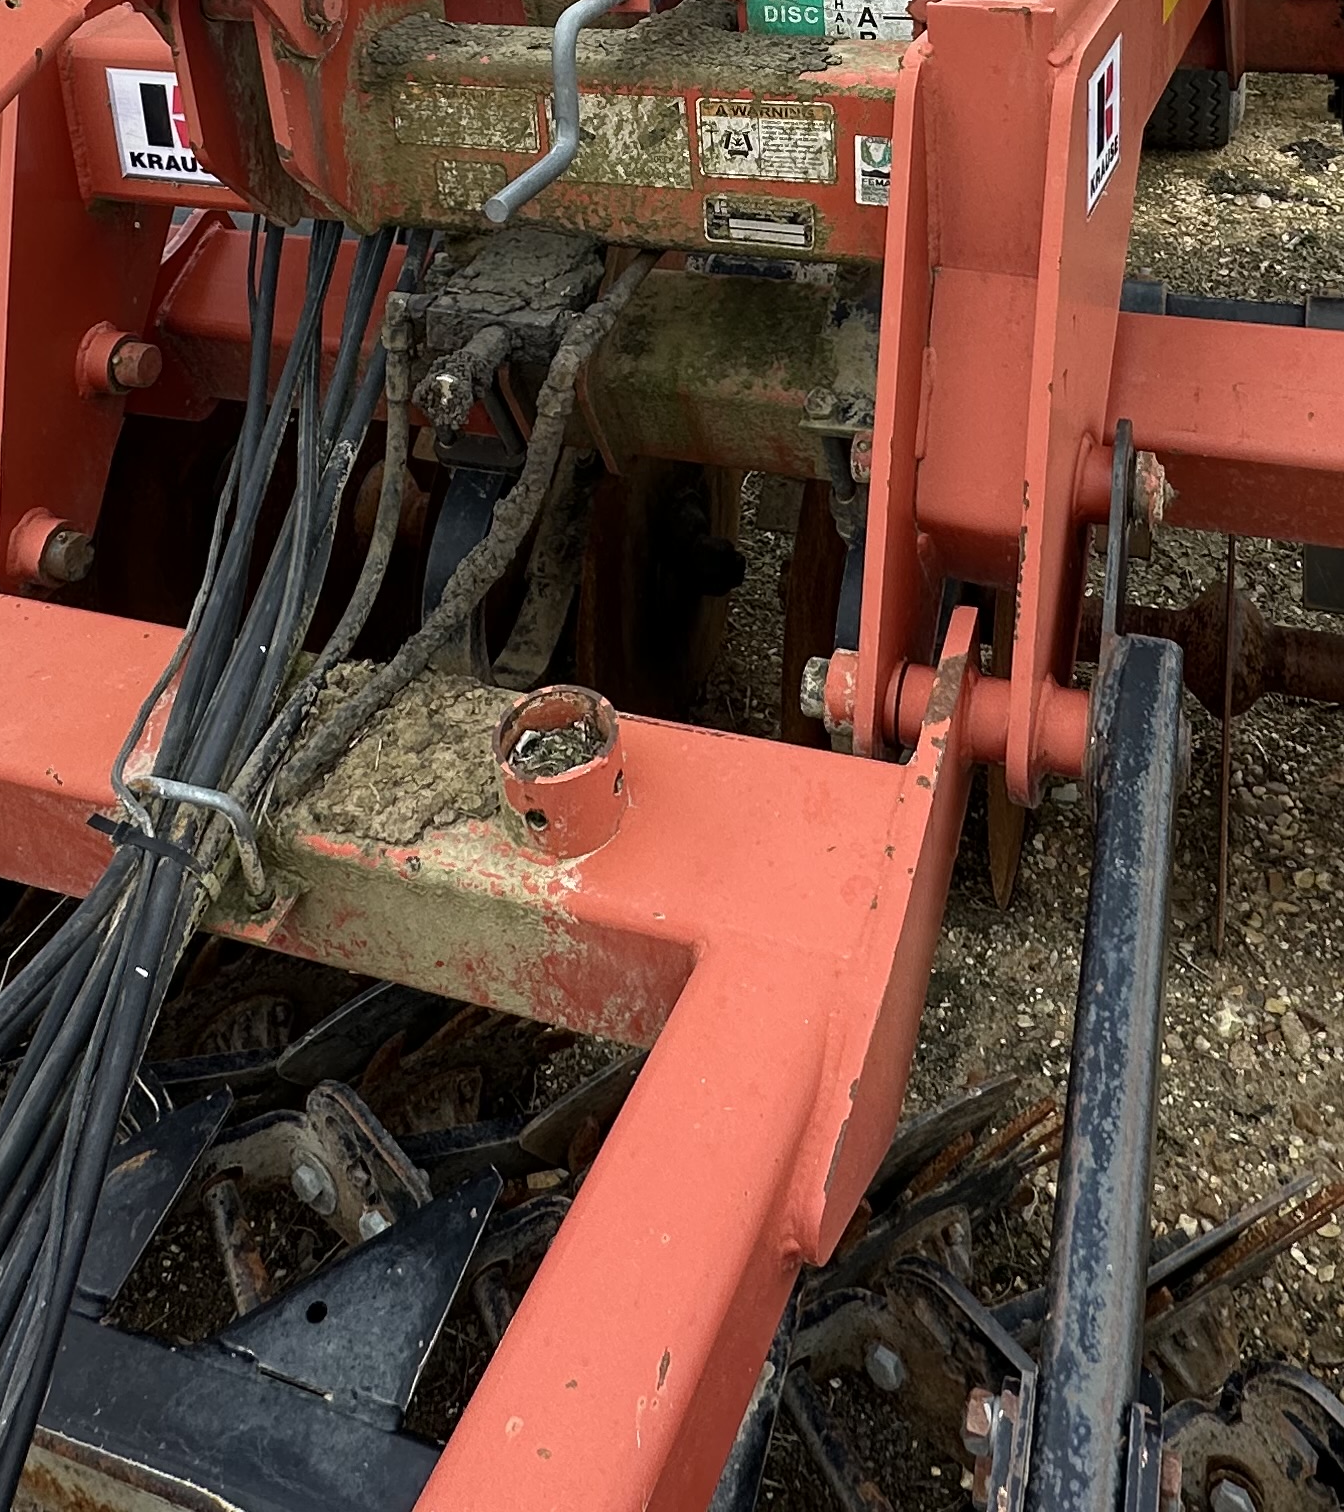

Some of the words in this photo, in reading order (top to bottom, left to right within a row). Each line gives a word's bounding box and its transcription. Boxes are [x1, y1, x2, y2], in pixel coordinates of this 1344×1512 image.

[763, 4, 820, 24] DISC
[857, 6, 878, 29] A
[129, 151, 211, 174] KRAU
[1089, 134, 1120, 198] KRAUSE
